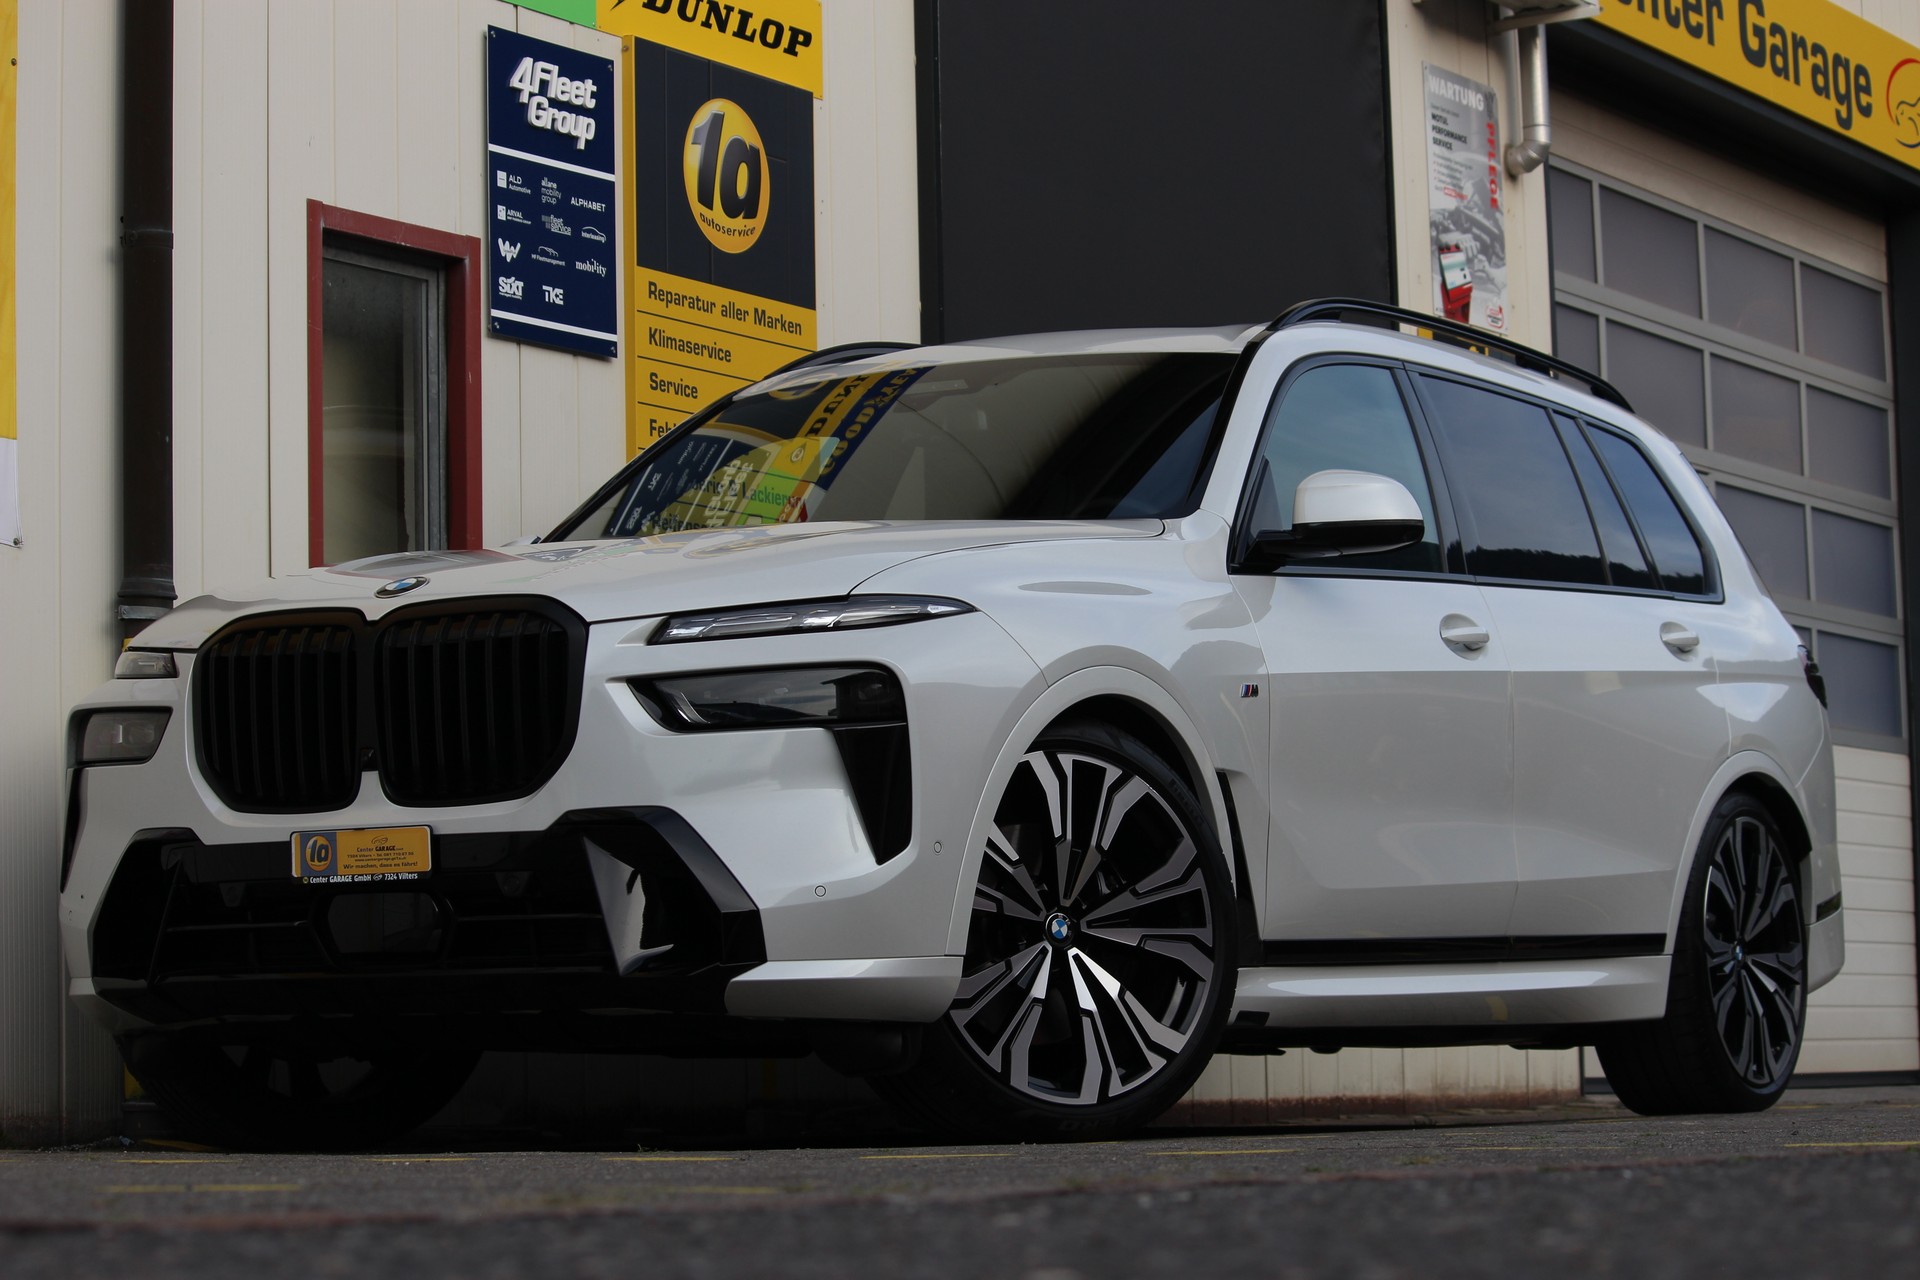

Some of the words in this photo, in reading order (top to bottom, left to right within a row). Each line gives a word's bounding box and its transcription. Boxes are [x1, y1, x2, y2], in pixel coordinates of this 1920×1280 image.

[1739, 0, 1873, 131] Garage
[509, 56, 597, 109] 4Fleet
[1429, 75, 1484, 111] WARTUNG
[528, 95, 596, 150] Group
[691, 109, 762, 219] 1a
[509, 175, 522, 184] ALD
[509, 184, 531, 195] Automotive
[507, 209, 523, 219] ARVAL
[570, 197, 606, 213] ALPHABET
[700, 212, 756, 238] autoservice
[575, 258, 607, 278] mobility
[648, 280, 716, 314] Reparatur
[721, 301, 750, 322] aller
[754, 307, 802, 336] Marken
[648, 326, 732, 363] Klimaservice
[649, 372, 698, 399] Service
[649, 418, 677, 438] Feh
[330, 875, 352, 883] GARAGE
[354, 874, 372, 882] GmbH
[384, 873, 398, 881] 7324
[398, 872, 418, 880] Vilters
